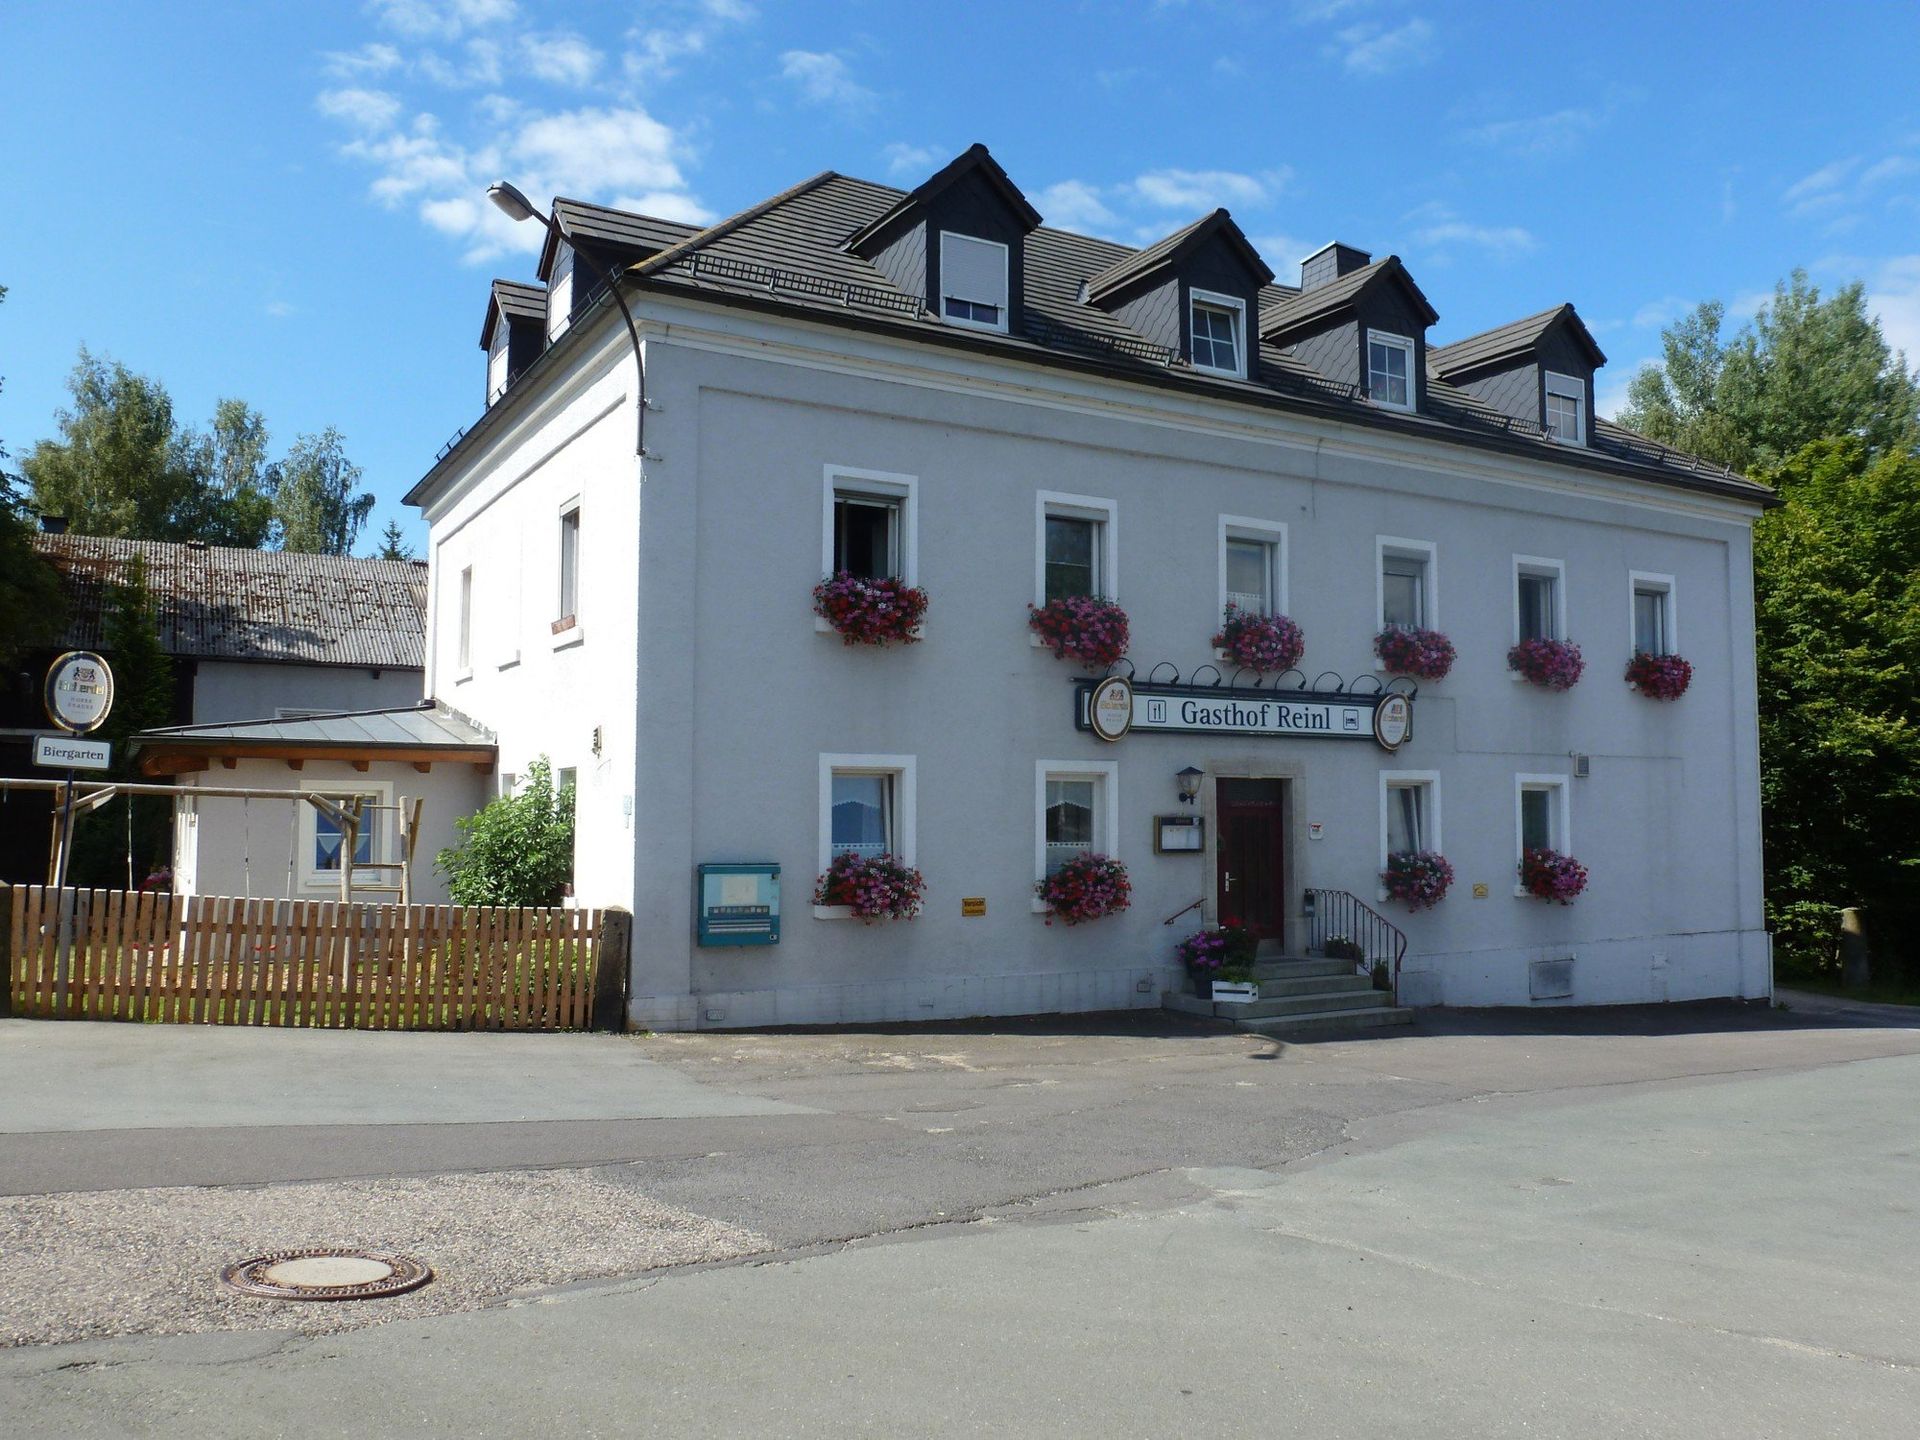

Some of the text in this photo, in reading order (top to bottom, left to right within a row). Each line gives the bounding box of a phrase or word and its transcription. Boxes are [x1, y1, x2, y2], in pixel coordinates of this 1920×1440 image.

[1181, 701, 1332, 730] Gasthof Reinl
[43, 746, 104, 761] Biergarten
